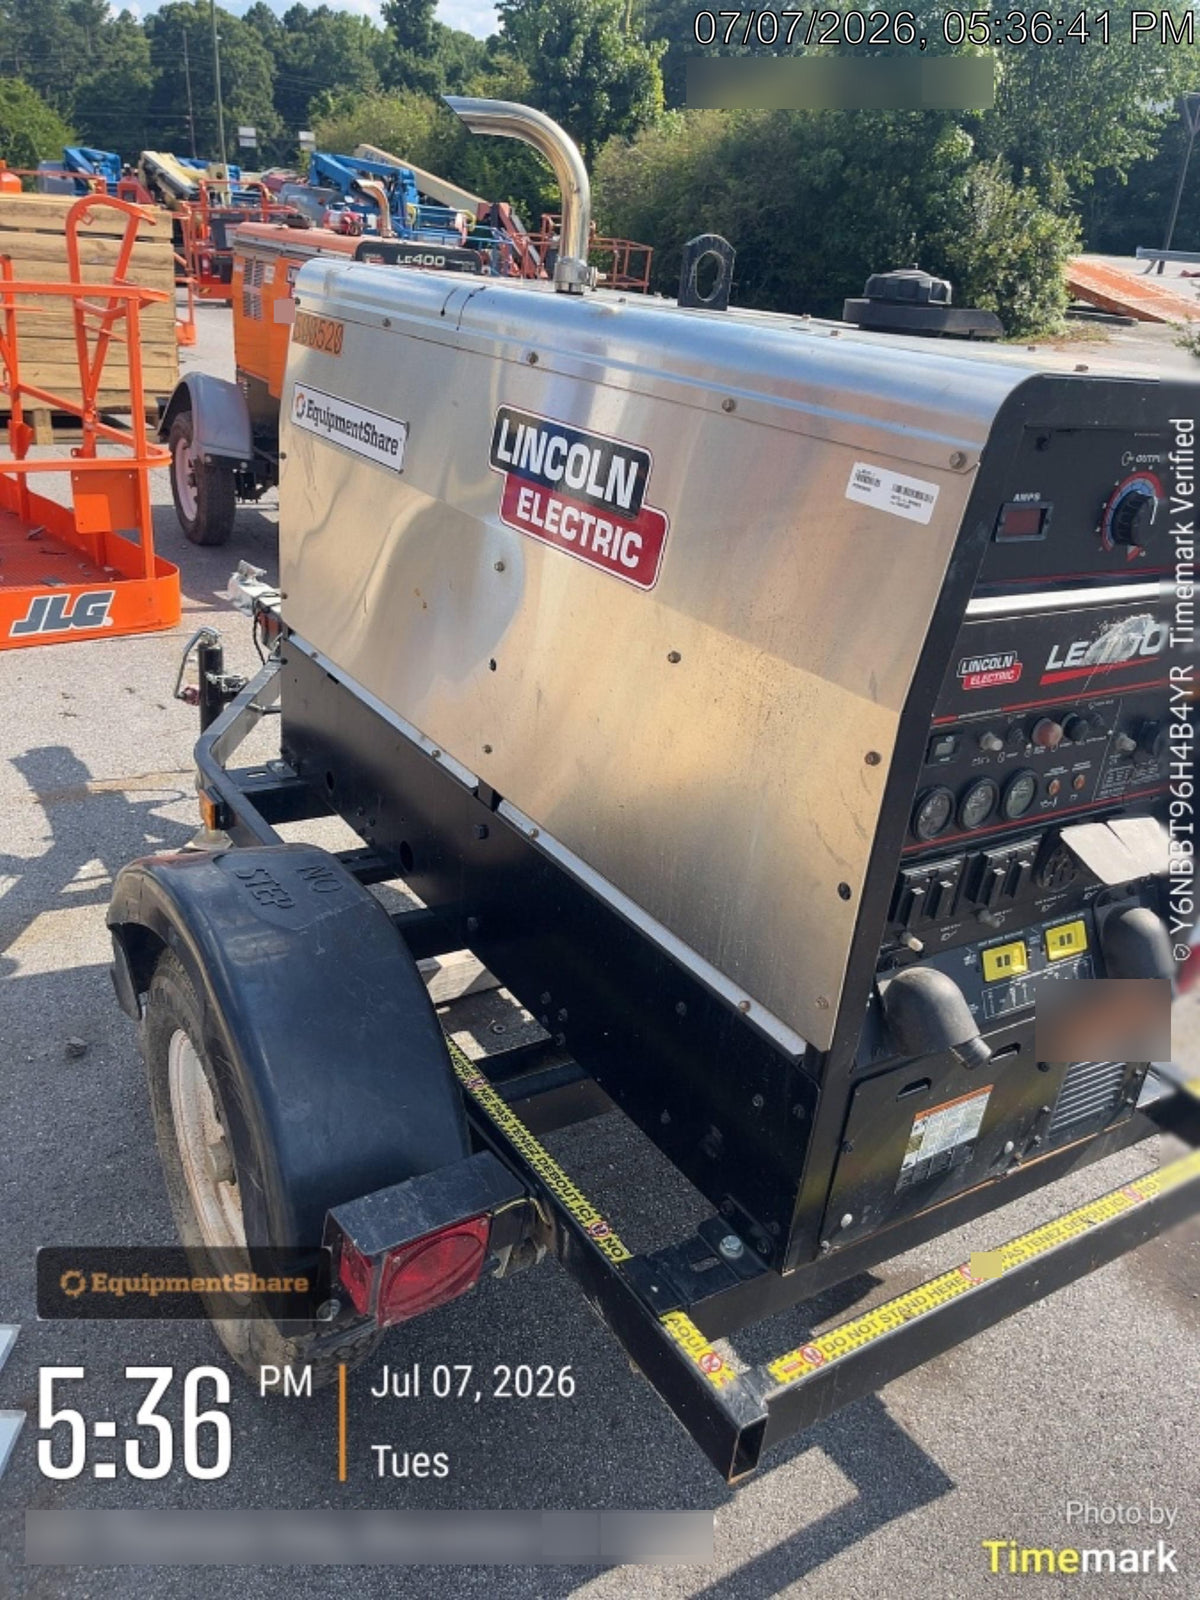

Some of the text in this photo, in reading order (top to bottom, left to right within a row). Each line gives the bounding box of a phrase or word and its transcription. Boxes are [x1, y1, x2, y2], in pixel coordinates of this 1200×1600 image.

[306, 399, 399, 456] EquipmentShare
[496, 419, 639, 510] LINCOLN
[1013, 491, 1041, 502] AMPS
[516, 487, 643, 569] ELECTRIC
[9, 590, 116, 637] JLG
[961, 655, 1014, 675] LINCOLN
[969, 669, 1016, 686] ELECTRIC
[234, 868, 297, 910] STEP
[296, 865, 344, 894] NO
[539, 1156, 581, 1202] DEBOUT
[575, 1204, 595, 1221] ICI
[604, 1237, 624, 1258] NO
[1023, 1228, 1063, 1250] TENEZ
[822, 1275, 965, 1354] DO NOT STAND HERE
